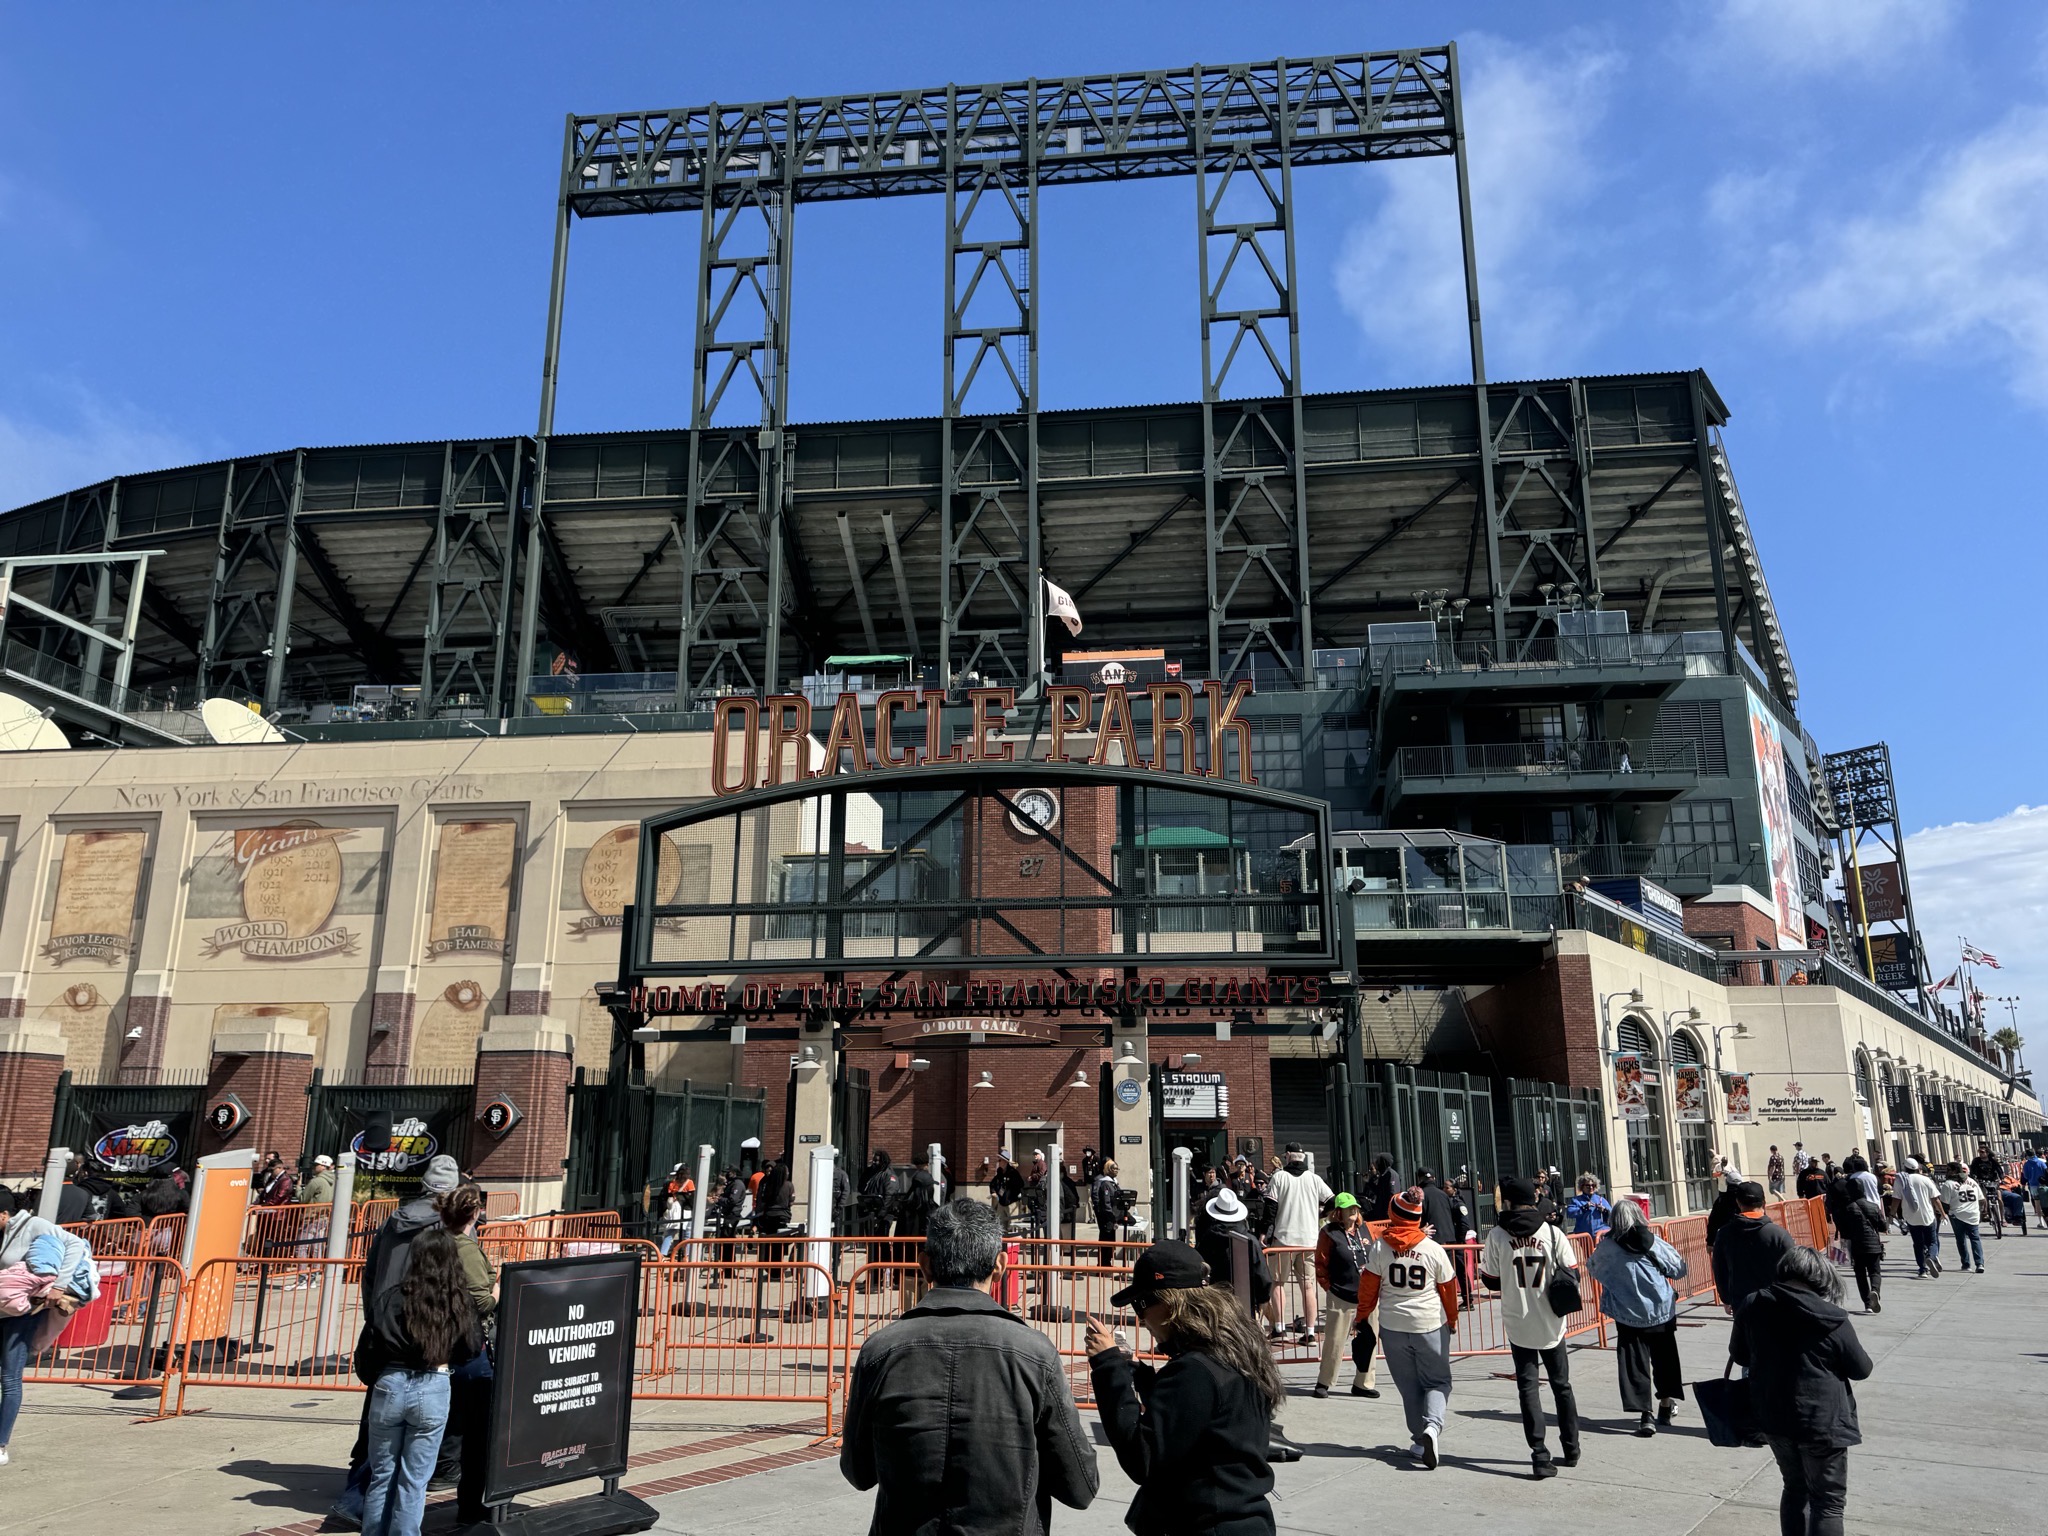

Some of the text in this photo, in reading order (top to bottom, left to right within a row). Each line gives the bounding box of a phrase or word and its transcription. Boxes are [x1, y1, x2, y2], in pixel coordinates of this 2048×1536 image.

[1090, 668, 1137, 685] GIANTS
[712, 679, 1258, 798] ORACLE PARK
[113, 779, 484, 809] New York & San Francisco Giants
[238, 829, 318, 883] Giants
[301, 848, 328, 858] 2010
[601, 849, 621, 859] 1971
[270, 856, 293, 868] 1905
[305, 861, 330, 870] 2012
[594, 861, 618, 873] 1987
[263, 869, 283, 880] 1921
[304, 874, 329, 885] 2014
[590, 875, 614, 887] 1989
[259, 881, 280, 891] 1922
[260, 893, 280, 905] 1933
[593, 889, 618, 899] 1997
[598, 901, 625, 909] 2000
[1866, 898, 1894, 911] ignity
[264, 906, 286, 918] 1954
[583, 917, 600, 928] NL
[602, 915, 624, 927] WE
[220, 922, 285, 943] WORLD
[455, 927, 482, 938] HALL
[52, 934, 126, 948] MAJOR LEAGUE
[244, 930, 345, 955] CHAMPIONS
[435, 939, 500, 951] OF FAMERS
[64, 946, 110, 958] RECORDS
[1875, 963, 1907, 973] ACHE
[1877, 971, 1906, 982] REEK
[629, 976, 1321, 1012] HOME OF THE SAN FRANCISCO GIANTS
[922, 1018, 1019, 1033] O'DOUL GATE
[1615, 1060, 1640, 1072] HICKS
[1172, 1074, 1221, 1083] STADIUM
[1676, 1070, 1700, 1080] RAMOS
[1163, 1088, 1195, 1096] OTHING
[1182, 1098, 1191, 1106] IT
[1767, 1097, 1824, 1107] Dignity Health
[126, 1120, 168, 1140] Radio
[392, 1117, 427, 1137] adio
[102, 1138, 171, 1157] LAZER
[111, 1154, 150, 1172] 1510
[367, 1152, 408, 1172] 1510
[1958, 1190, 1977, 1203] 35
[1509, 1236, 1543, 1251] MOORE
[1392, 1250, 1422, 1262] MOORE
[1389, 1263, 1426, 1291] 09
[1512, 1256, 1546, 1288] 17
[568, 1304, 584, 1321] NO
[528, 1320, 615, 1346] UNAUTHORIZED
[548, 1343, 596, 1364] VENDING
[541, 1371, 599, 1391] ITEMS SUBJECT TO
[532, 1383, 602, 1404] CONFISCATION UNDER
[540, 1395, 596, 1415] DPW ARTICLE 5.9
[540, 1447, 568, 1465] ORACLE
[568, 1443, 587, 1455] PARK
